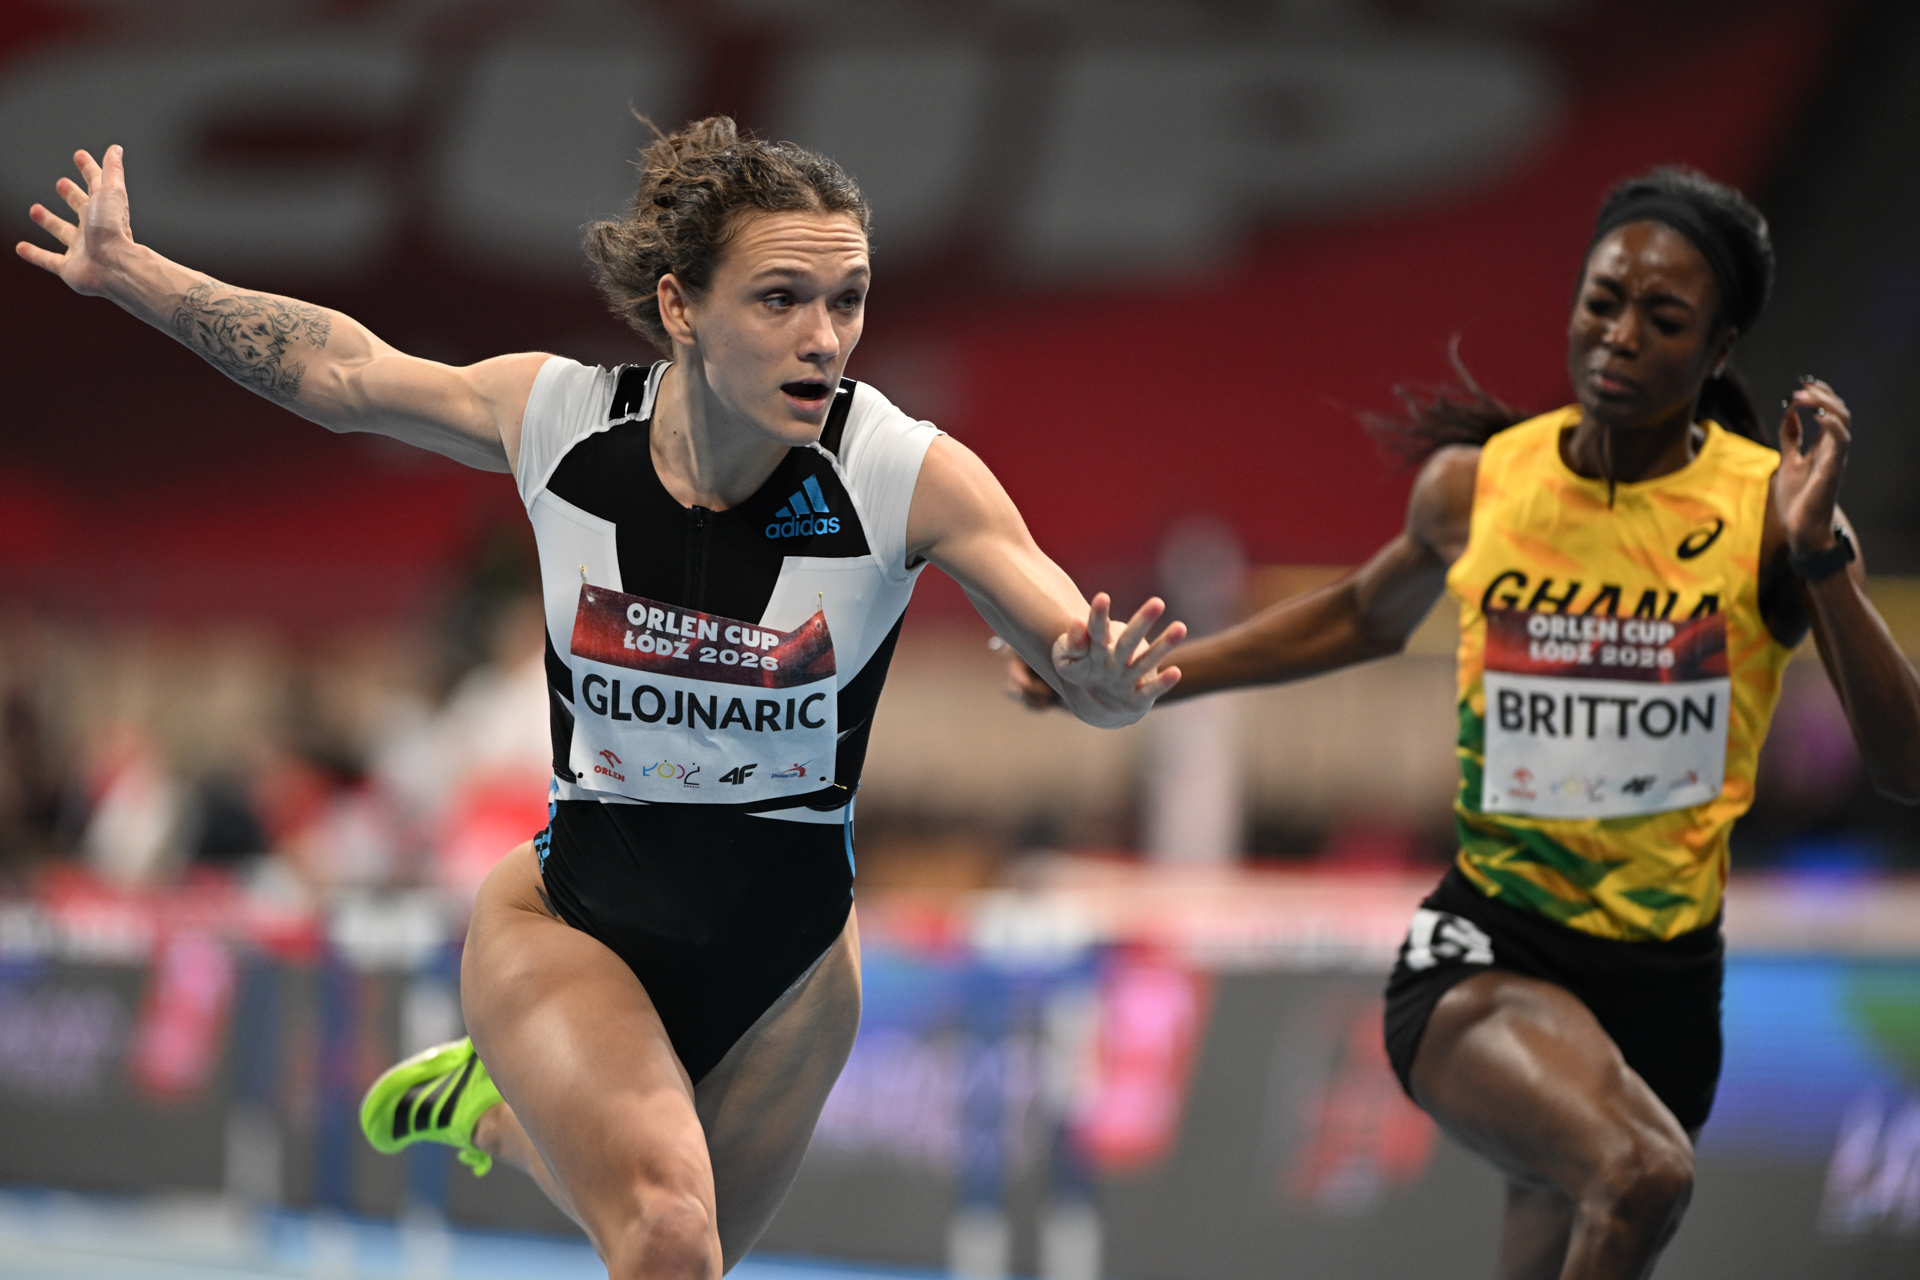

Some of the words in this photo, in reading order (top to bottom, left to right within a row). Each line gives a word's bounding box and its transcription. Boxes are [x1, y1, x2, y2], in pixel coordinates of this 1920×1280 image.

[765, 513, 840, 539] adidas
[626, 602, 718, 642] ORLEN
[724, 625, 779, 651] CUP
[1527, 614, 1619, 643] ORLEN
[1622, 619, 1676, 646] CUP
[623, 630, 691, 660] ŁÓDŹ
[699, 646, 779, 671] 2026
[1601, 643, 1676, 669] 2026
[582, 673, 827, 732] GLOJNARIC
[1497, 689, 1717, 740] BRITTON
[594, 765, 625, 782] ORLEN
[719, 763, 758, 785] 4F
